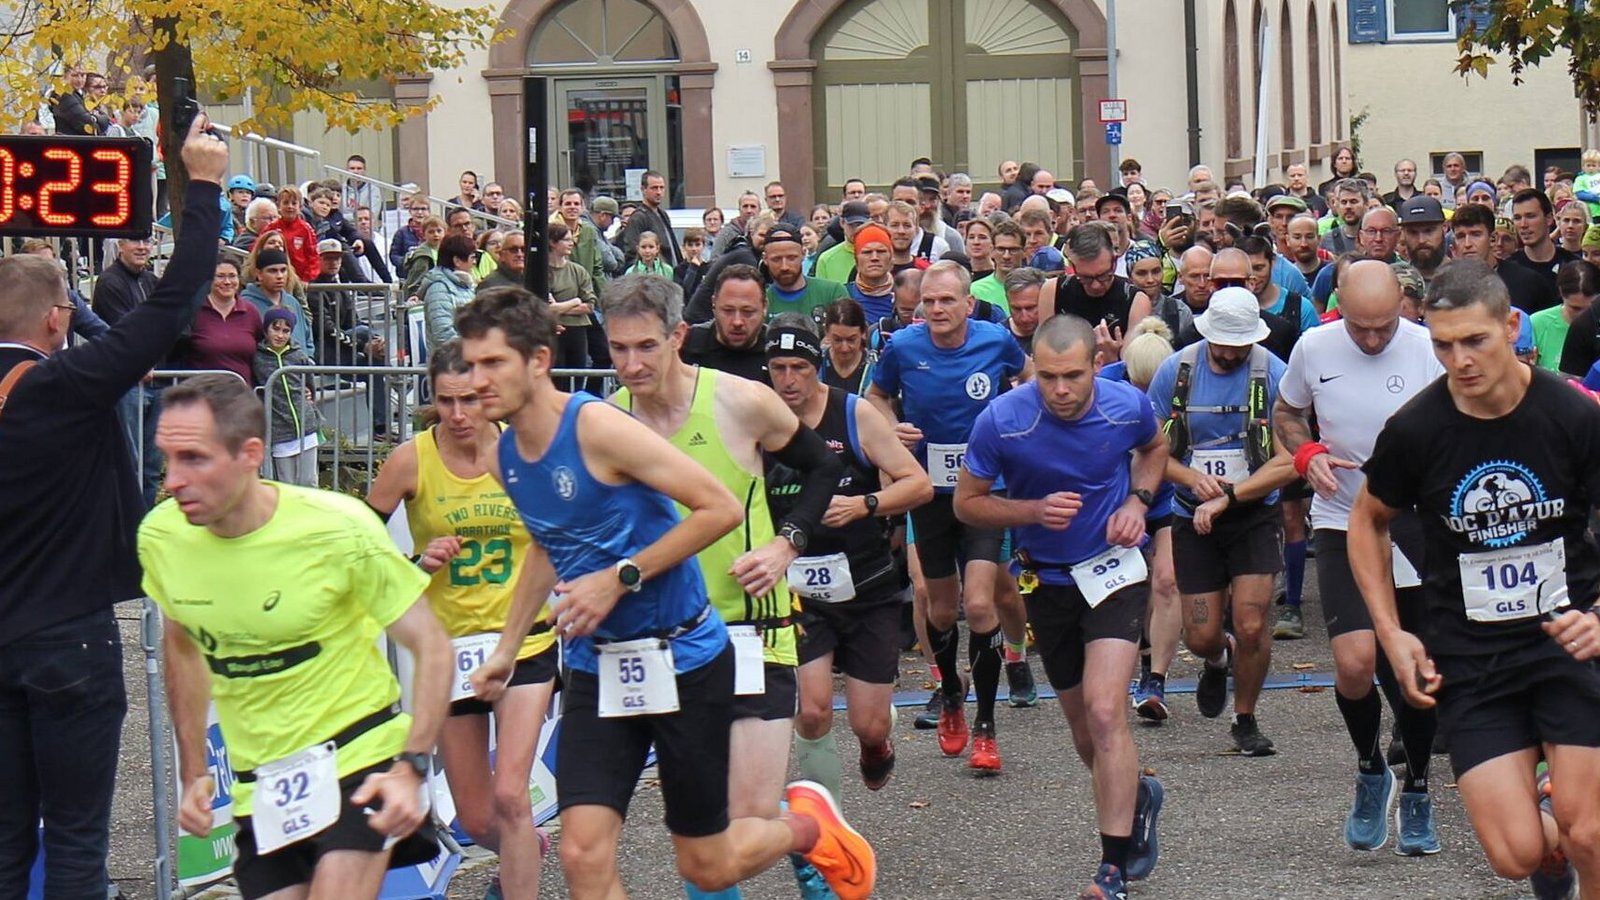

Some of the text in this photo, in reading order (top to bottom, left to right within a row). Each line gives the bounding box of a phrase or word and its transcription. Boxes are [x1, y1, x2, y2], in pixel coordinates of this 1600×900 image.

[738, 51, 749, 60] 14
[946, 475, 958, 483] GL
[1204, 460, 1226, 476] 18
[444, 503, 519, 525] TWO RIVERS
[1440, 498, 1565, 533] OC D'AZUR
[455, 524, 511, 537] MARATHON
[1468, 520, 1538, 543] FINISHER
[450, 539, 512, 586] 23
[804, 567, 831, 586] 28
[1481, 561, 1538, 590] 104
[457, 647, 485, 672] 61
[618, 656, 646, 684] 55
[274, 771, 311, 807] 32
